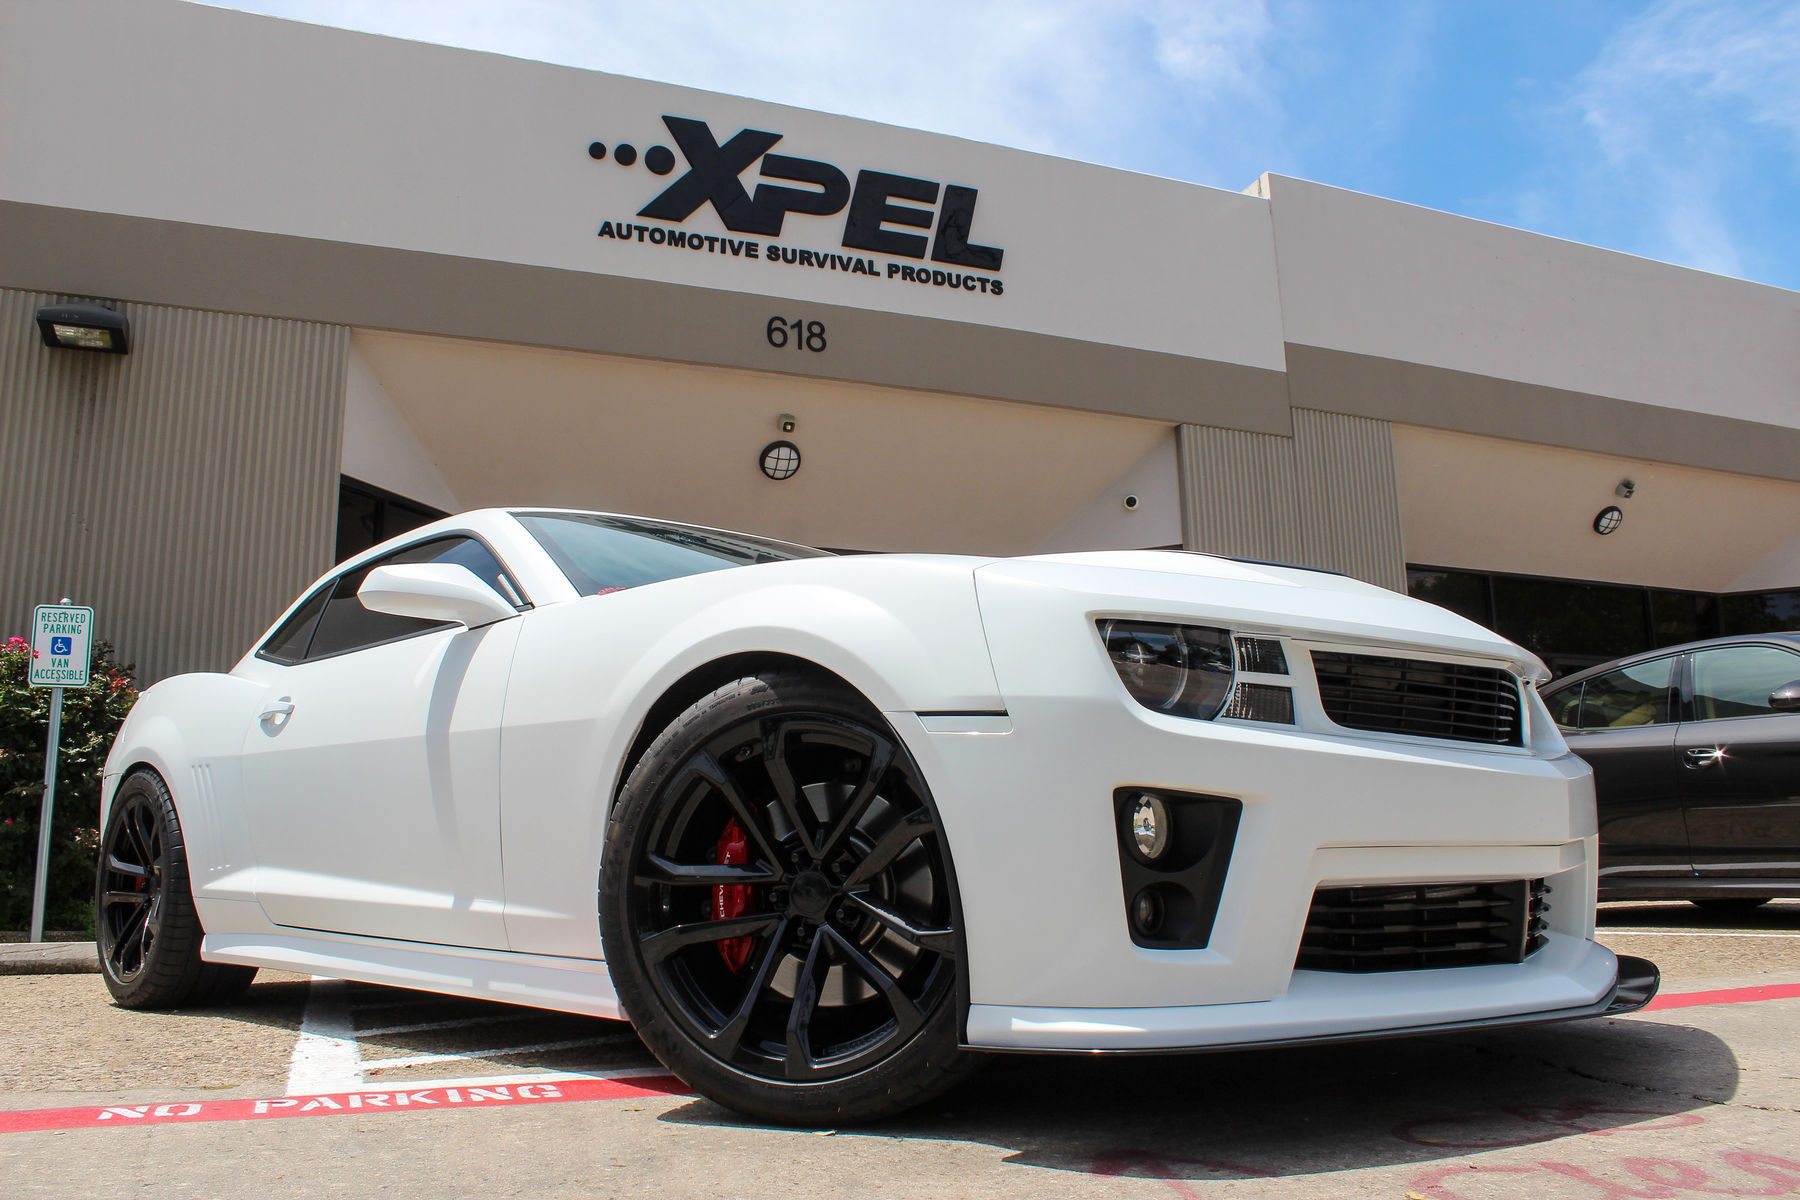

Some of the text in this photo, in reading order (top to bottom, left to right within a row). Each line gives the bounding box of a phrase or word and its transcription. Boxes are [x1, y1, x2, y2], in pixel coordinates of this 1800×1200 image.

[636, 115, 1004, 272] XPEL
[598, 221, 1004, 296] AUTOMOTIVE SURVIVAL PRODUCTS
[766, 315, 828, 353] 618
[42, 612, 86, 623] RESERVED
[43, 623, 82, 634] PARKING
[34, 669, 84, 680] ACCESSIBLE
[51, 658, 70, 668] VAN
[97, 1084, 563, 1120] NO PARKING
